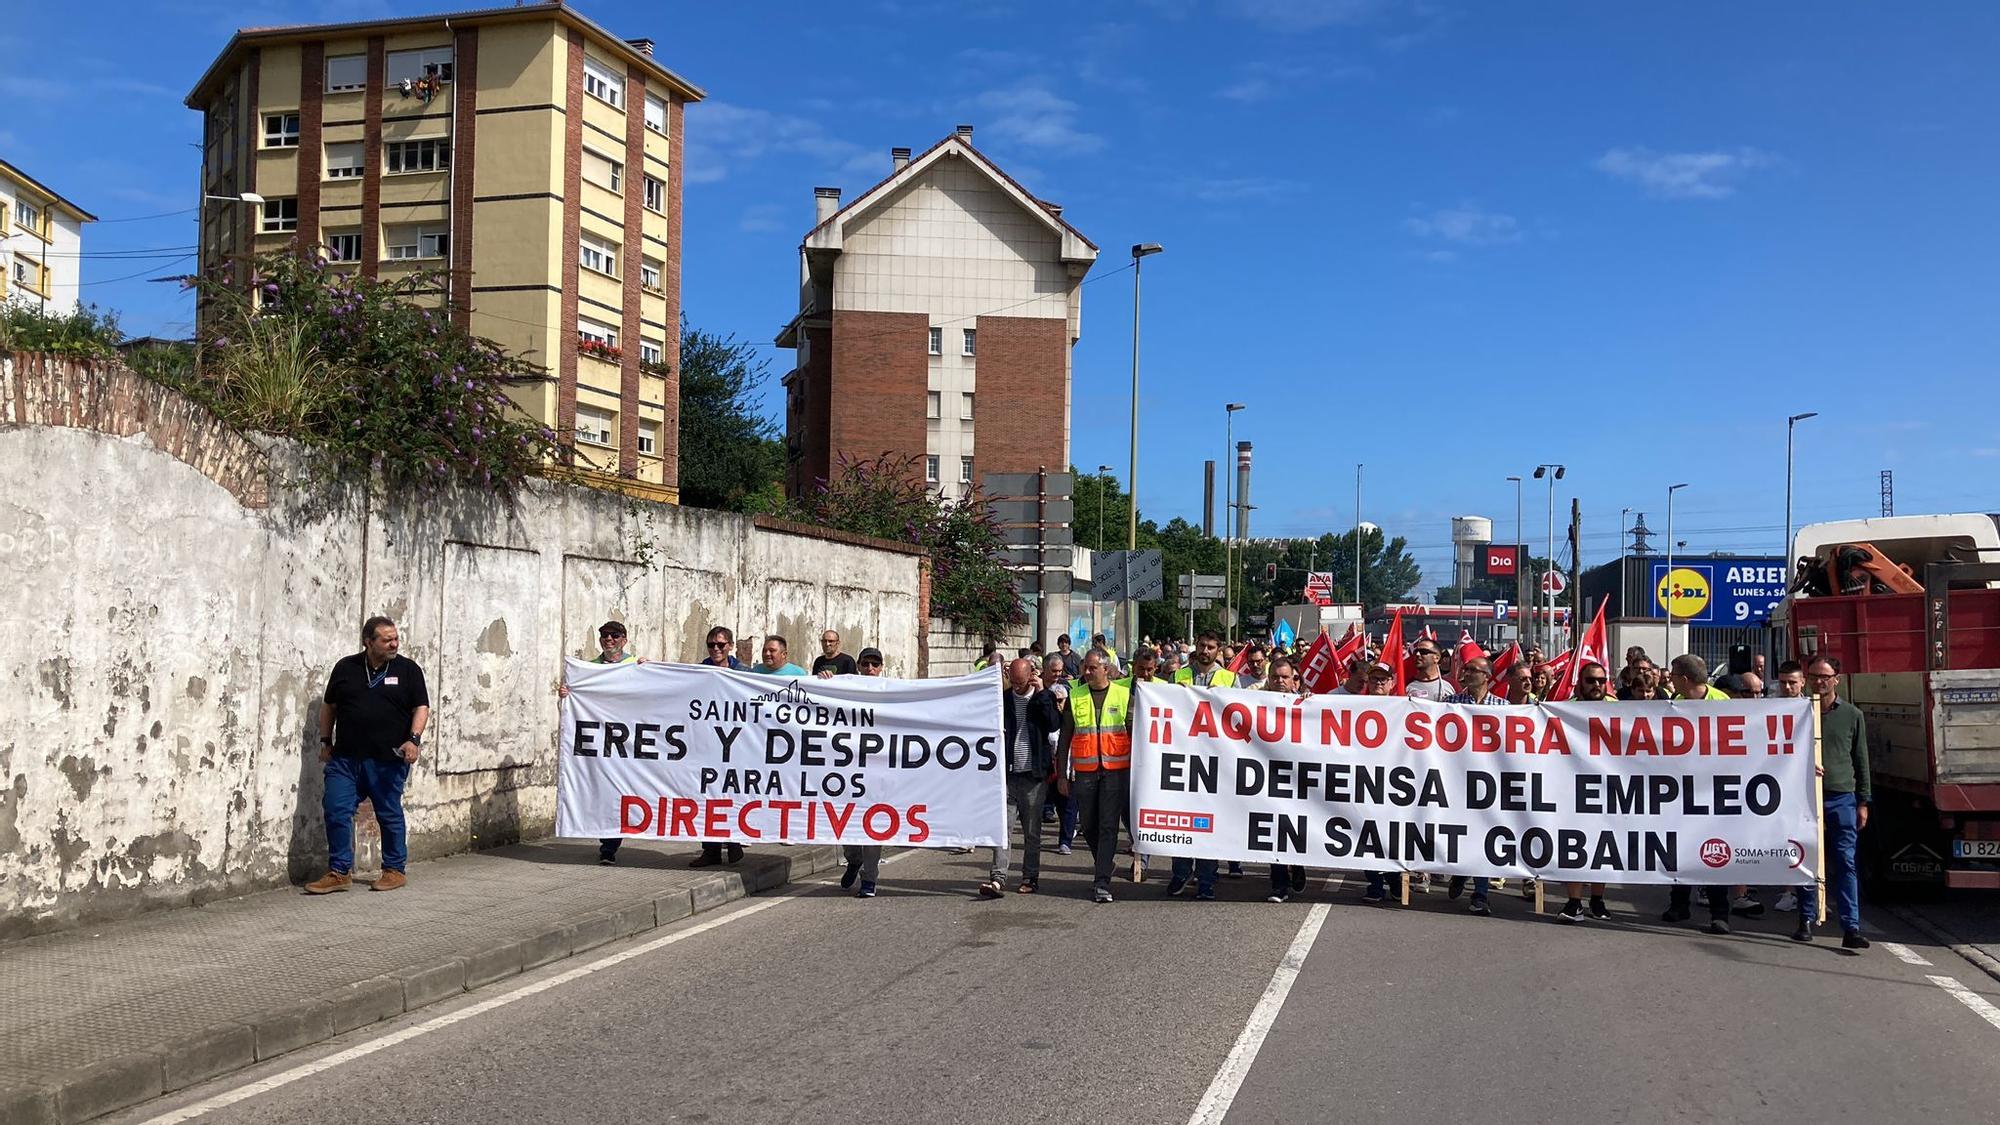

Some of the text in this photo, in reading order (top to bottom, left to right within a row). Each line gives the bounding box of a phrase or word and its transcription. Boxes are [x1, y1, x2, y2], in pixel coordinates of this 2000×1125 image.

[1660, 583, 1706, 600] LIDL
[1733, 588, 1765, 597] LUNES
[1496, 605, 1506, 620] P
[1734, 601, 1750, 621] 9
[689, 699, 875, 728] SAINT-GOBAIN
[1188, 696, 1302, 744] AQUÍ
[1320, 708, 1388, 749] NO
[1404, 711, 1571, 755] SOBRA
[1589, 716, 1747, 756] NADIE
[1766, 715, 1794, 755] !!
[573, 720, 998, 772] ERES Y DESPIDOS
[700, 767, 866, 798] PARA LOS
[1160, 752, 1781, 816] EN DEFENSA DEL EMPLEO
[620, 795, 930, 842] DIRECTIVOS
[1143, 813, 1191, 828] CCOO
[1138, 830, 1193, 845] industria
[1248, 811, 1678, 872] EN SAINT GOBAIN
[1703, 842, 1728, 857] UGT
